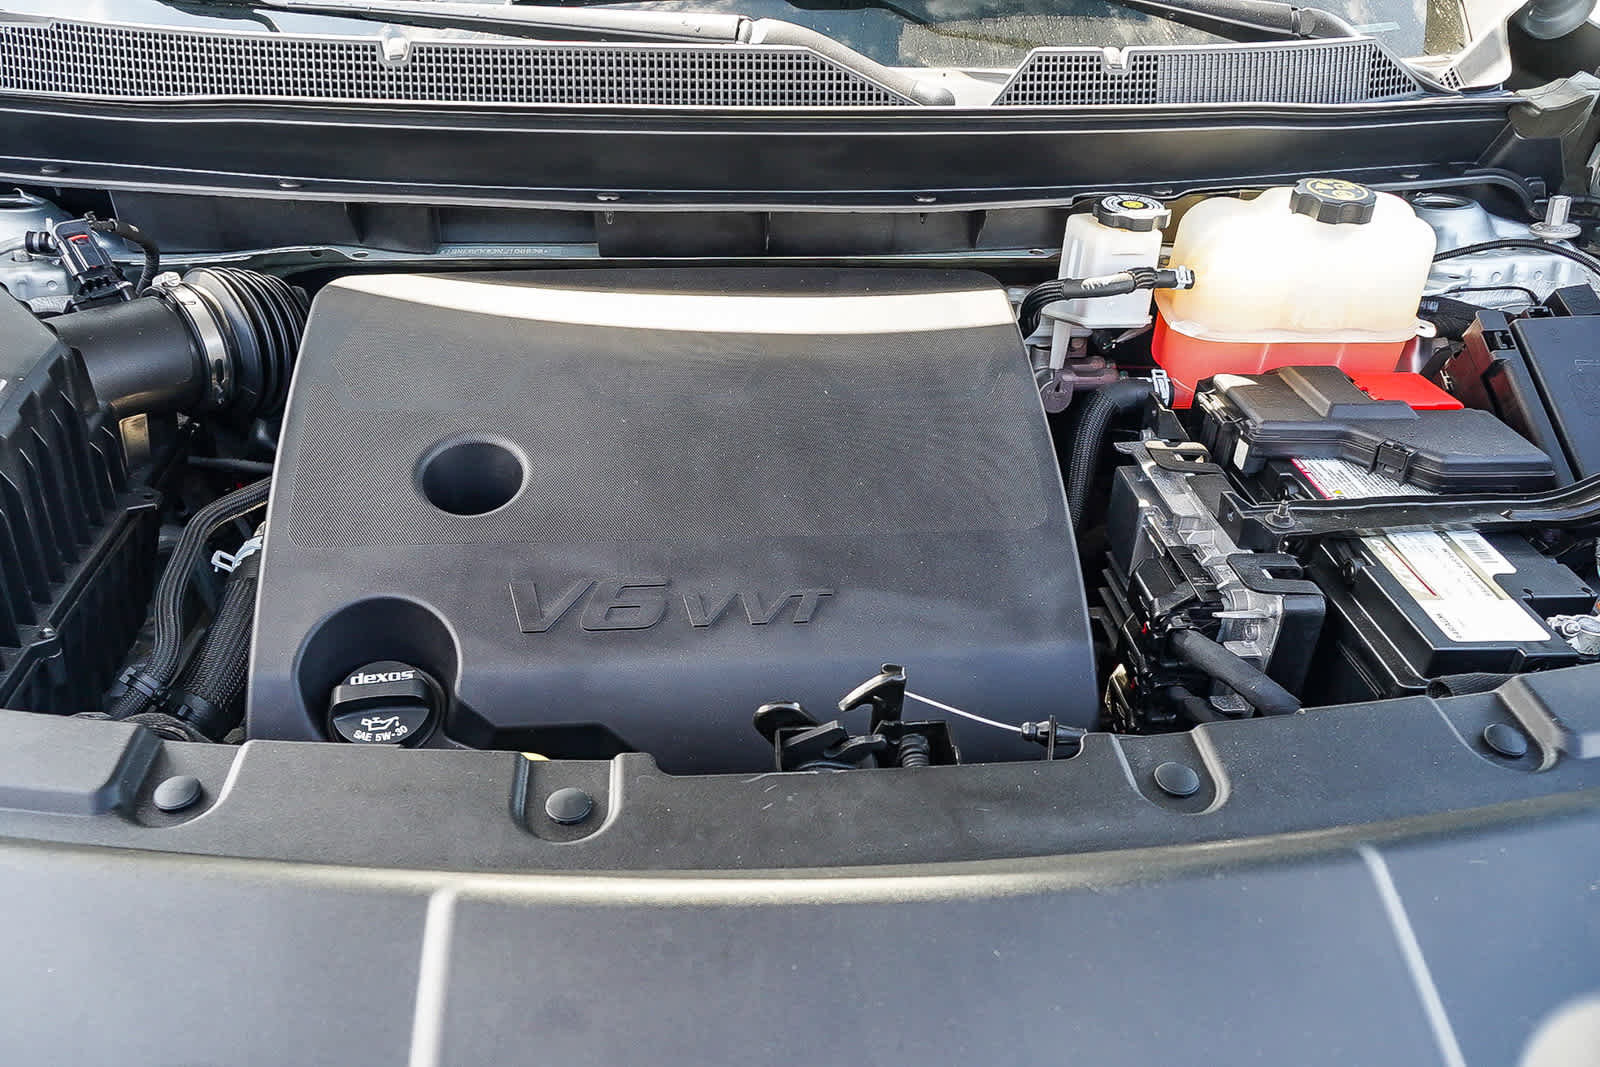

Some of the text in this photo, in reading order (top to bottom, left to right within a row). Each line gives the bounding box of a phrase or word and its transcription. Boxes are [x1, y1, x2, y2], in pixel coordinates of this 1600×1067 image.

[508, 577, 836, 634] V6 VVT
[350, 670, 416, 685] dexos
[353, 726, 408, 741] SAE 5W-30
